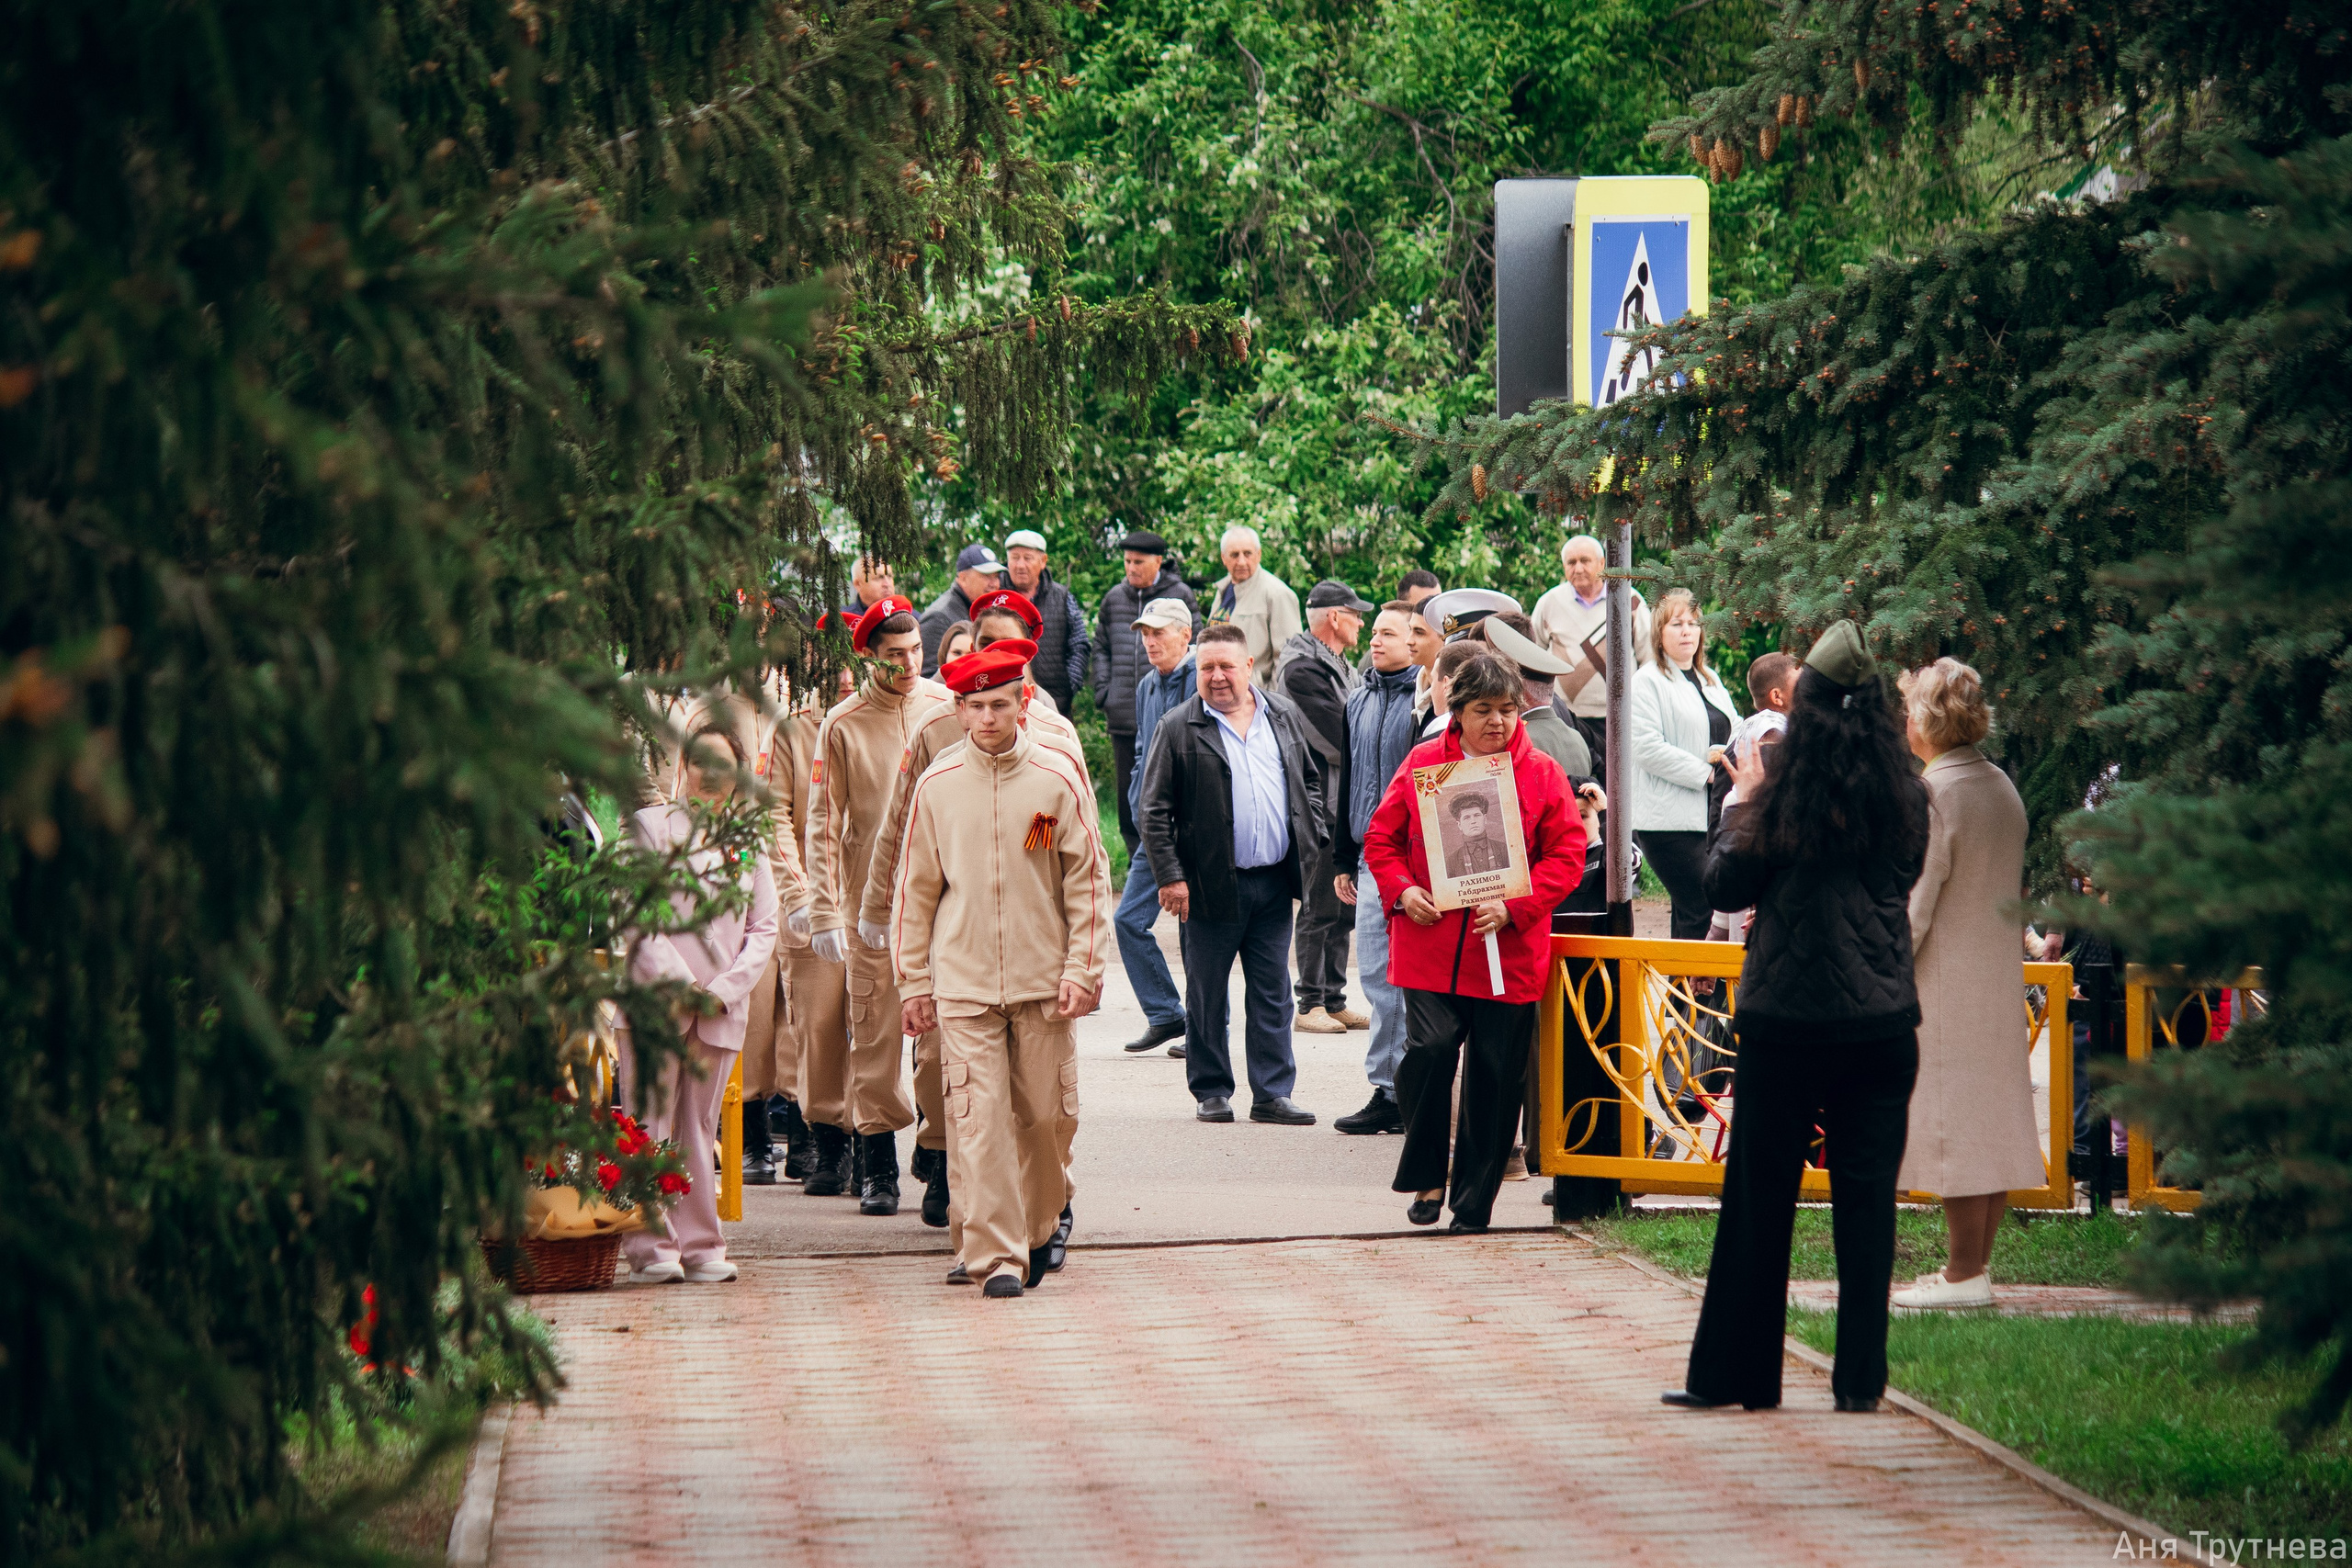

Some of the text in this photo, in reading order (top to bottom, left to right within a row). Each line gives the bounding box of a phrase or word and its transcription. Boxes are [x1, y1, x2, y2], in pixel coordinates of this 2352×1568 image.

[1460, 874, 1501, 887] РАХИМОВ
[1458, 884, 1506, 897] Габдрахман
[1461, 893, 1506, 906] Рахимович
